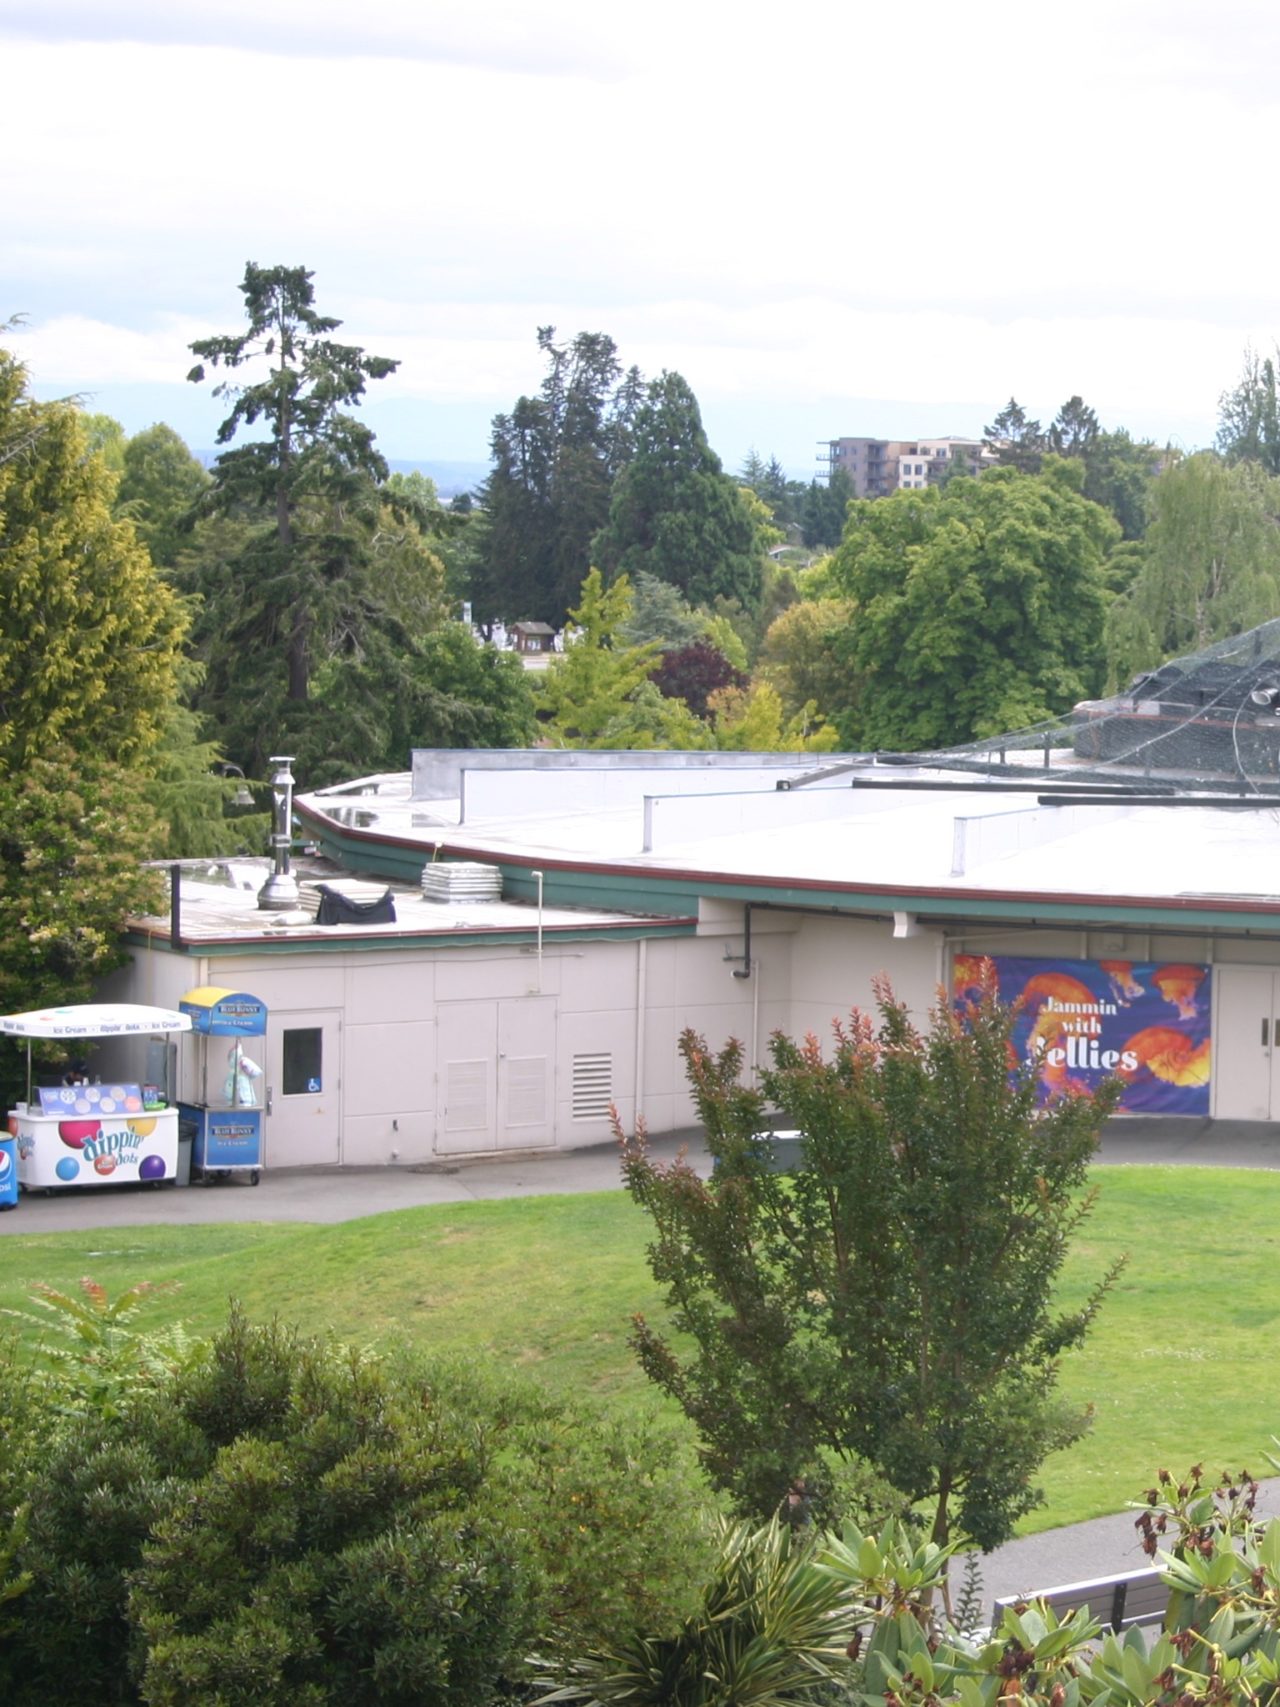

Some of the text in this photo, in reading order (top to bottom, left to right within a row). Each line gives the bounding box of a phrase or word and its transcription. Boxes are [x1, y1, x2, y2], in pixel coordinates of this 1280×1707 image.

[1042, 996, 1117, 1015] Jammin
[1062, 1016, 1102, 1034] with
[116, 1152, 138, 1166] dots
